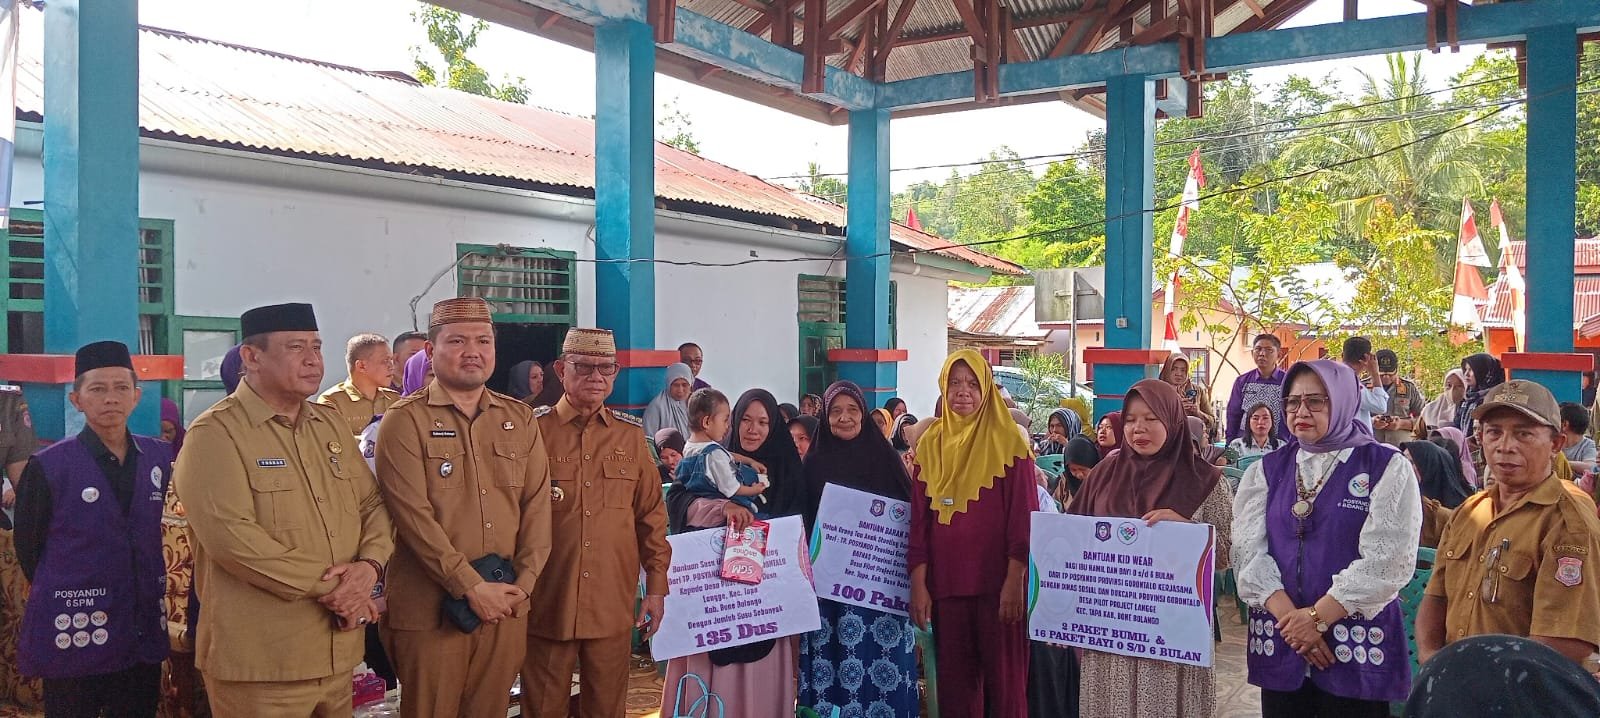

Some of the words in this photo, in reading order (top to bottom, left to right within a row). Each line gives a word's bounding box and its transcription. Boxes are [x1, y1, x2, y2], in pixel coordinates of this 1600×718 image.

[1342, 498, 1370, 507] POSYAND
[858, 520, 885, 533] BANTUAN
[1083, 550, 1116, 563] BANTUAN
[1117, 553, 1131, 564] KID
[1132, 555, 1153, 567] WEAR
[672, 562, 699, 573] Bantuan
[692, 569, 721, 581] POSYAND
[731, 564, 754, 575] SGM
[1065, 561, 1078, 570] BAGI
[1078, 563, 1088, 571] IBU
[1088, 564, 1106, 574] HAMIL
[1106, 566, 1118, 574] DAN
[1119, 567, 1132, 576] BAYI
[1138, 569, 1149, 579] s/d
[1155, 571, 1175, 581] BULAN
[1048, 570, 1061, 579] DARI
[1097, 576, 1124, 587] PROVINSI
[1124, 579, 1157, 590] GORONTALO
[1157, 584, 1193, 595] KERJASAMA
[55, 587, 107, 599] POSYANDU
[830, 583, 866, 602] 100
[868, 590, 910, 612] Pake
[1040, 580, 1061, 590] DENGAN
[1061, 583, 1078, 592] DINAS
[1078, 585, 1097, 595] SOSIAL
[1097, 587, 1110, 596] DAN
[1110, 589, 1138, 600] DUKCAPIL
[1138, 592, 1166, 603] PROVINSI
[1166, 595, 1201, 607] GORONTALO
[72, 598, 95, 608] SPM
[1078, 596, 1093, 605] DESA
[1093, 598, 1109, 607] PILOT
[1109, 601, 1134, 610] PROJECT
[1134, 603, 1157, 613] LANGGE
[687, 618, 712, 630] Dengan
[713, 614, 736, 625] Jumlah
[753, 604, 783, 618] Sebanyak
[1089, 608, 1102, 617] TAPA
[694, 627, 733, 648] 135
[736, 621, 779, 640] Dus
[1061, 622, 1068, 631] 2
[1070, 622, 1109, 637] PAKET
[1111, 628, 1150, 643] BUMIL
[1155, 635, 1166, 646] &
[1034, 628, 1047, 638] 16
[1049, 630, 1086, 644] PAKET
[1088, 636, 1114, 649] BAYI
[1126, 642, 1146, 653] S/D
[1149, 646, 1156, 655] 6
[1159, 647, 1202, 662] BULAN
